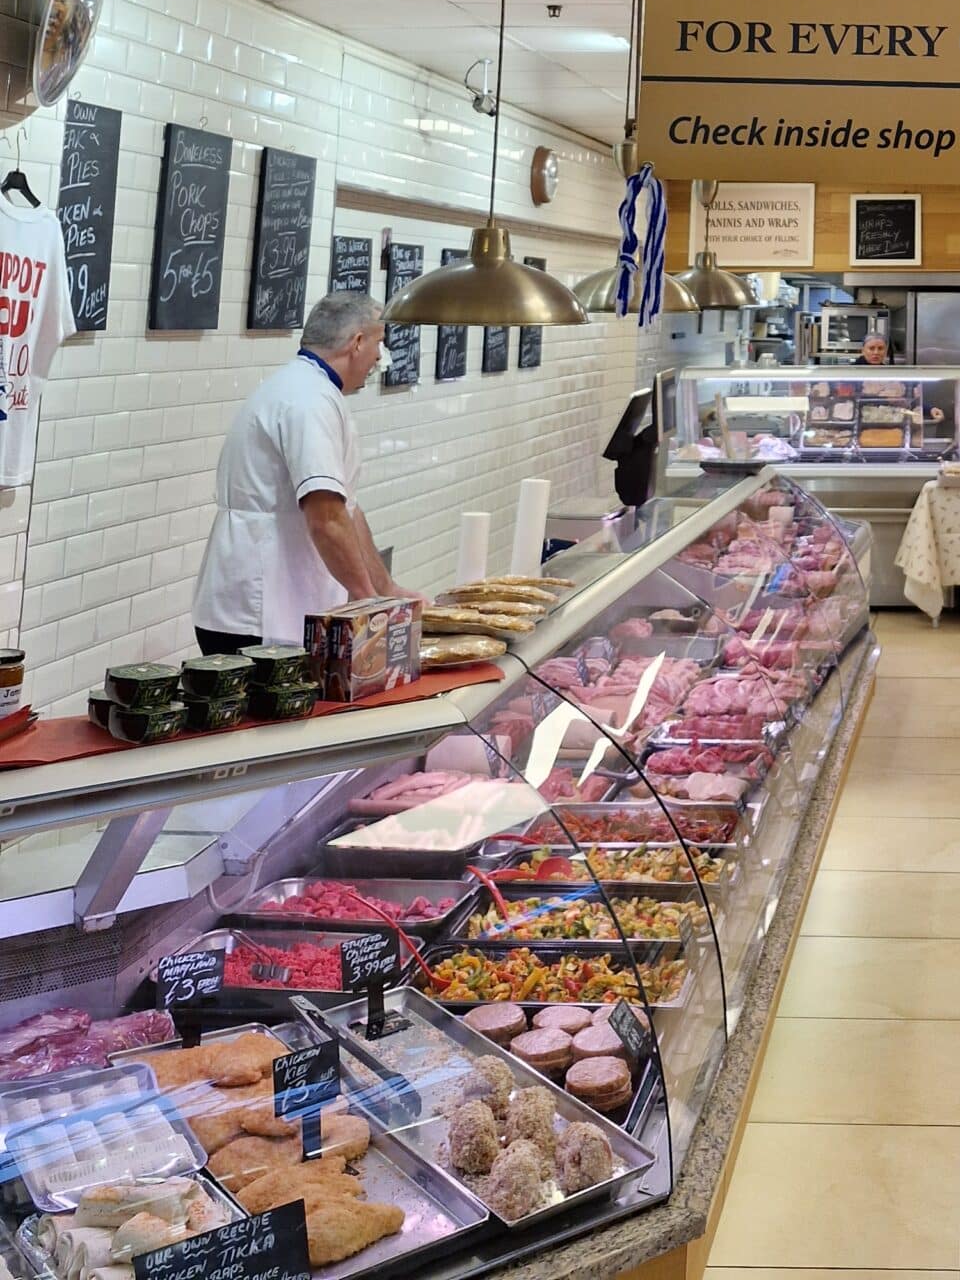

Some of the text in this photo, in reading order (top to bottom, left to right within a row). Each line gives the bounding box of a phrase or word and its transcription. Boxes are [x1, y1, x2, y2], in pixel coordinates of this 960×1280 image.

[676, 20, 774, 54] FOR
[788, 23, 949, 58] EVERY
[668, 116, 767, 147] Check
[774, 118, 869, 150] inside
[877, 120, 959, 157] shop
[704, 200, 800, 212] OLLS, SANDWICHES,
[745, 218, 764, 228] AND
[768, 218, 799, 228] WRAPS
[66, 223, 96, 252] PIES
[160, 248, 183, 302] 5
[164, 978, 196, 1007] £3
[145, 1248, 175, 1270] OUR
[181, 1233, 212, 1255] OWN
[216, 1232, 276, 1267] TIKKA
